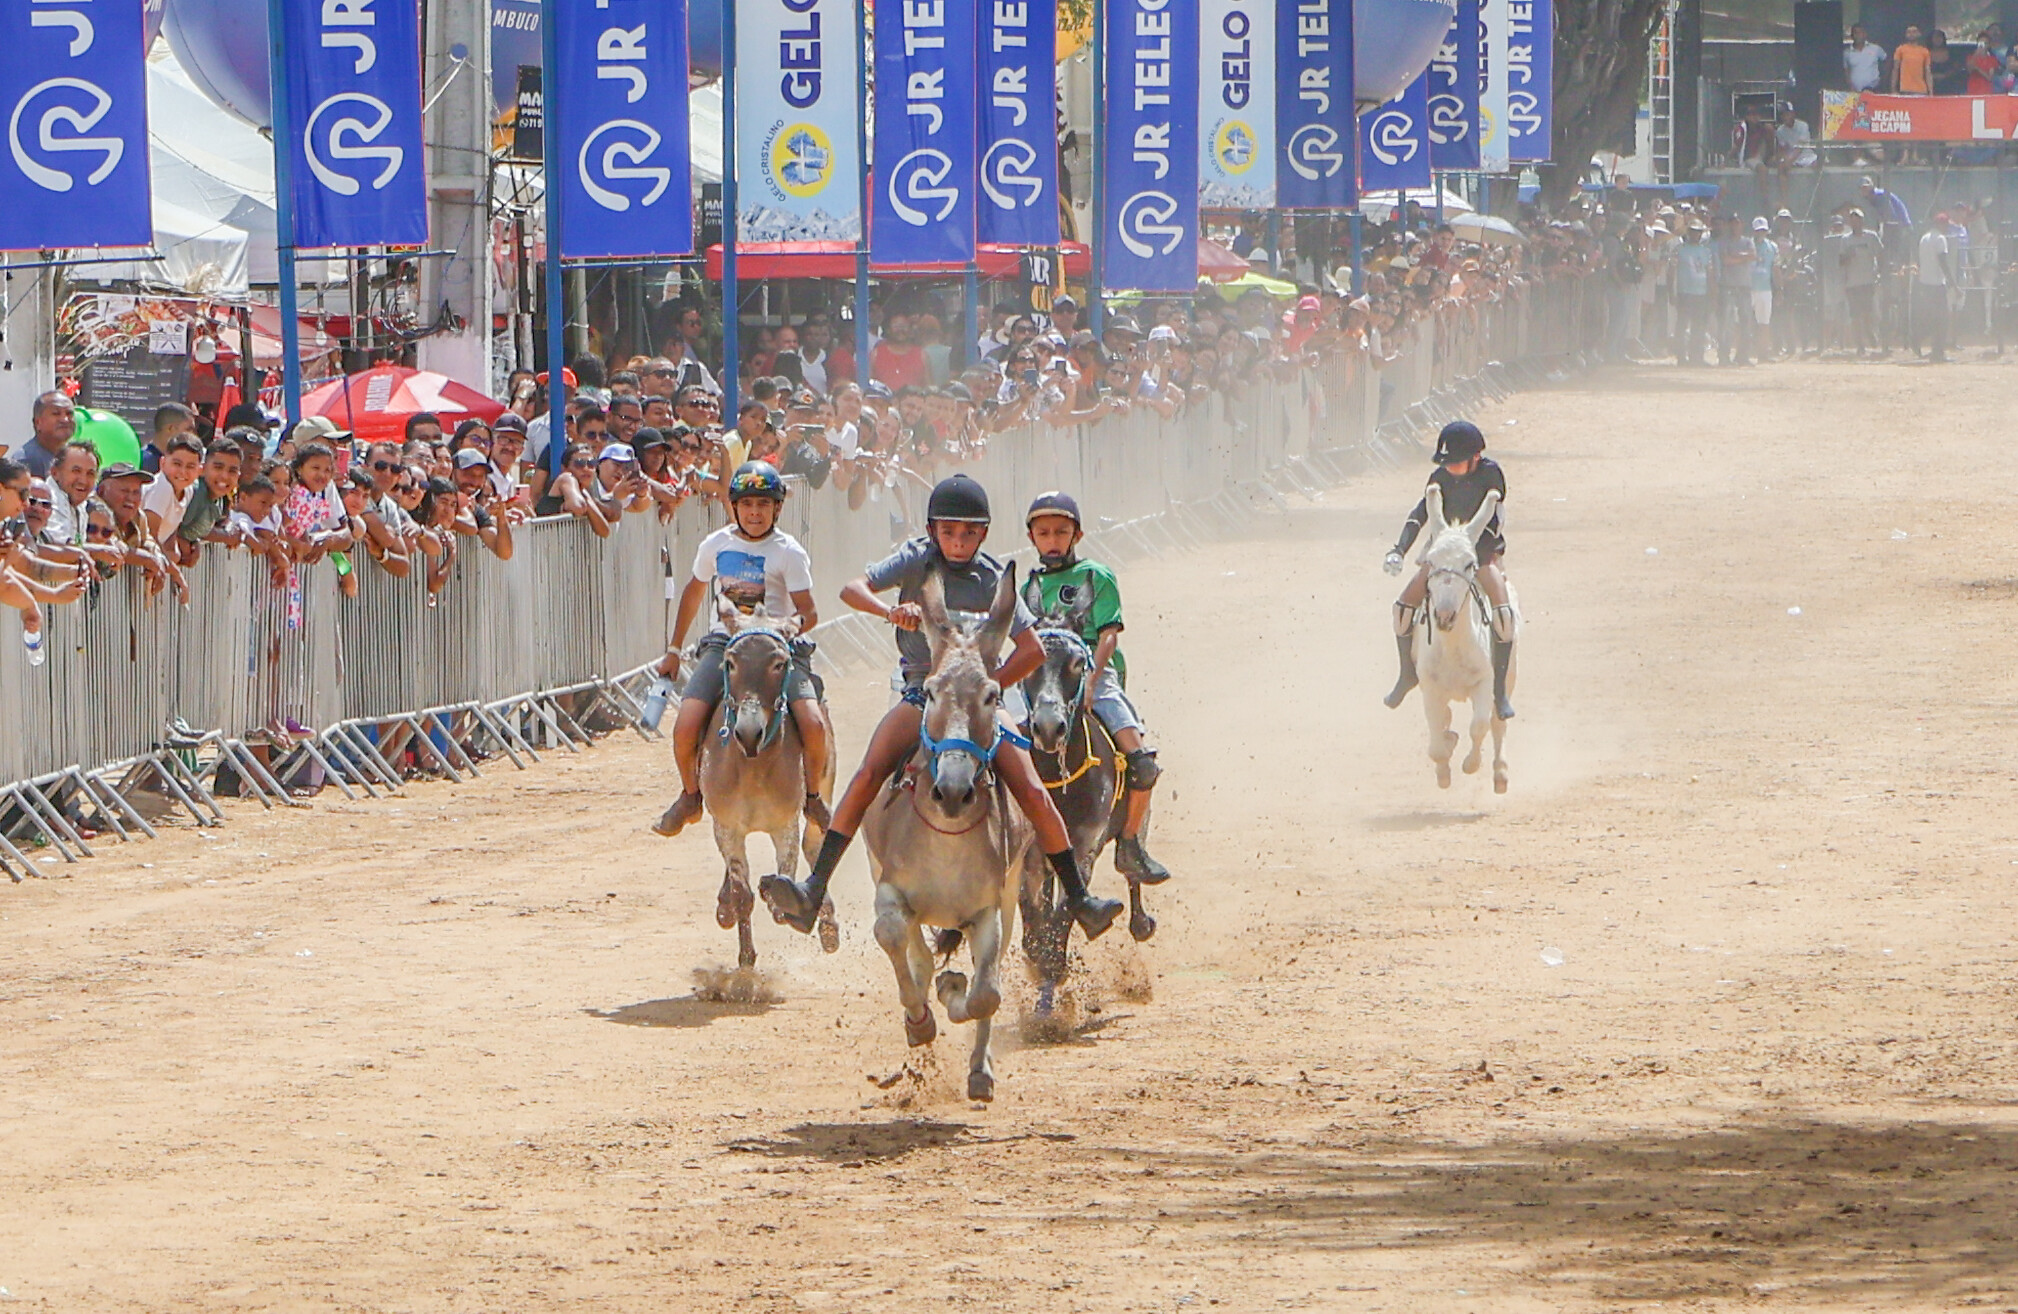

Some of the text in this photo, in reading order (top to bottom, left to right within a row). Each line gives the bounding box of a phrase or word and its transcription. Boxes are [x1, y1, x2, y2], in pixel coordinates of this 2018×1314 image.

[321, 0, 377, 75] JR
[596, 22, 648, 104] JR
[1222, 10, 1251, 110] GELO
[1507, 45, 1533, 85] JR
[906, 67, 944, 136] JR
[992, 65, 1028, 127] JR
[1298, 65, 1331, 115] JR
[761, 119, 786, 201] GELO CRISTALINO
[1133, 121, 1170, 180] JR
